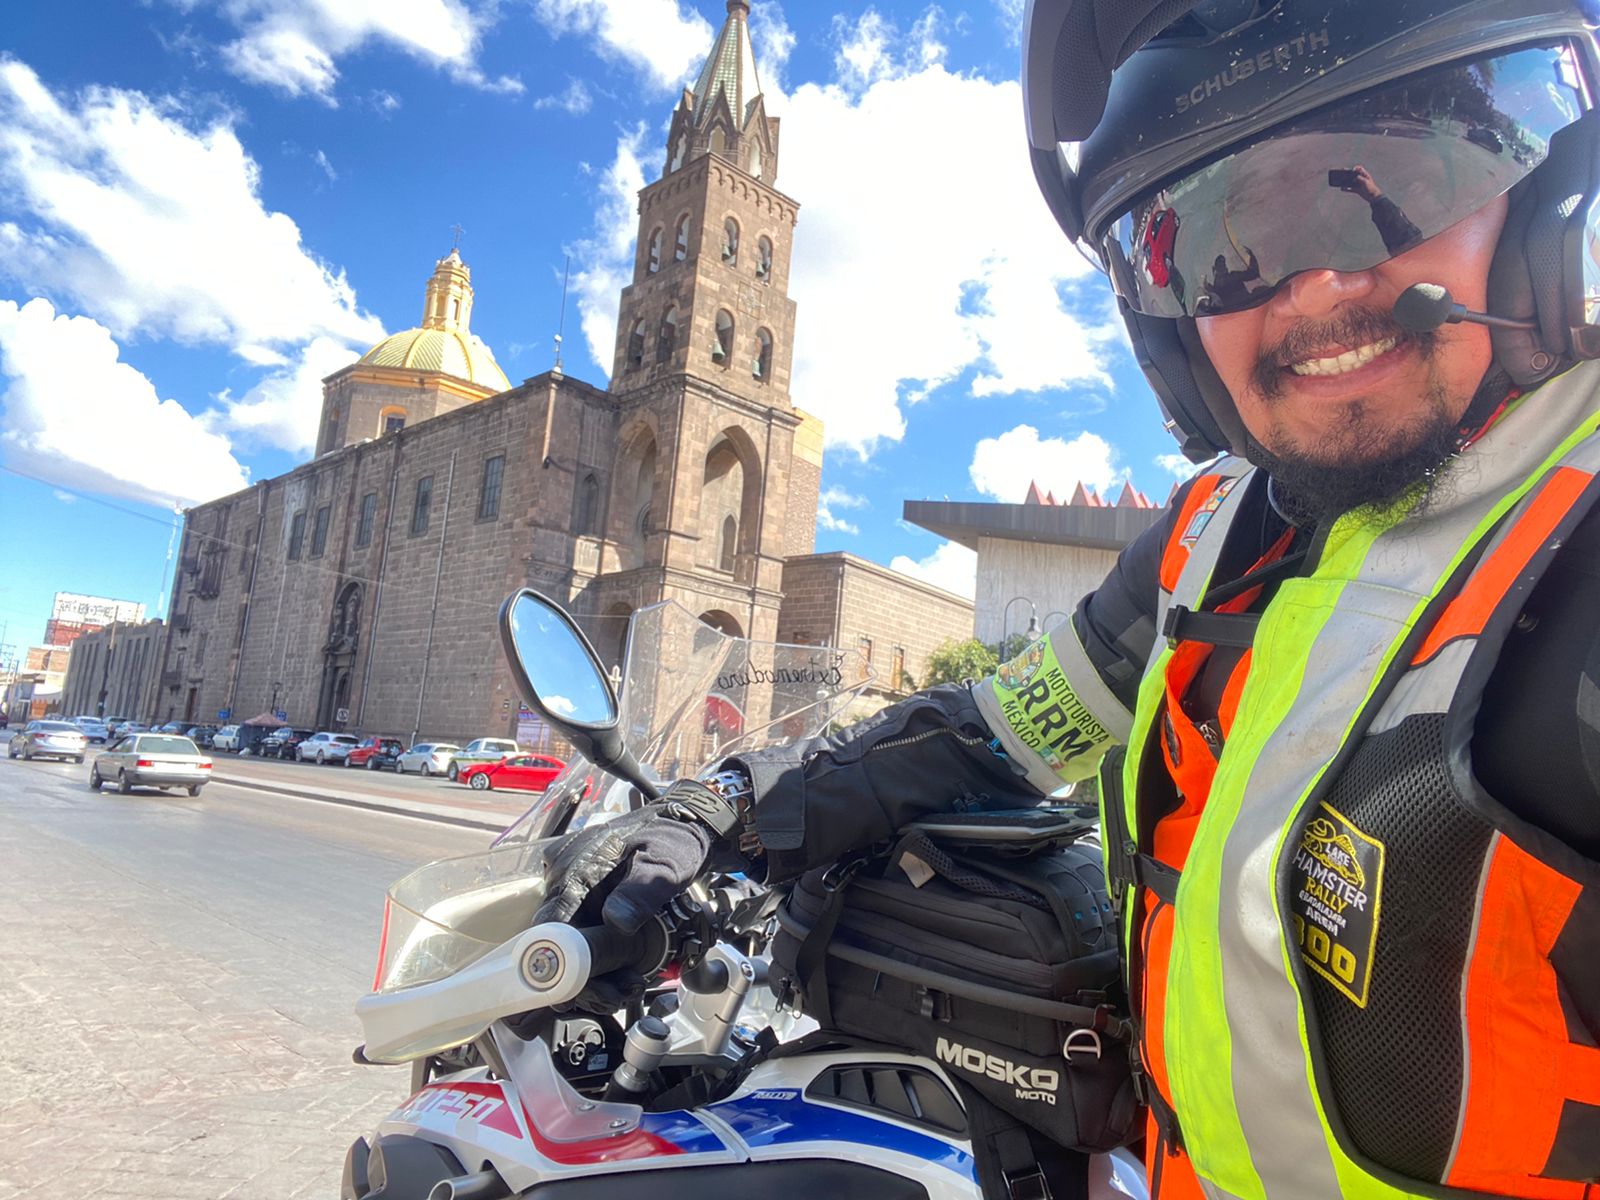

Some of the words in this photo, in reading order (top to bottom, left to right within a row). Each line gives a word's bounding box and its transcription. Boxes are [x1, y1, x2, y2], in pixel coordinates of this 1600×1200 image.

[1175, 28, 1330, 114] SCHUBERTH
[1015, 677, 1095, 762] RRM
[1045, 667, 1110, 743] MOTOTURISTA
[1292, 848, 1368, 912] HAMSTER
[1324, 842, 1351, 867] LAKE
[1304, 876, 1348, 914] RALLY
[935, 1036, 1060, 1091] MOSKO
[1015, 1087, 1057, 1106] MOTO
